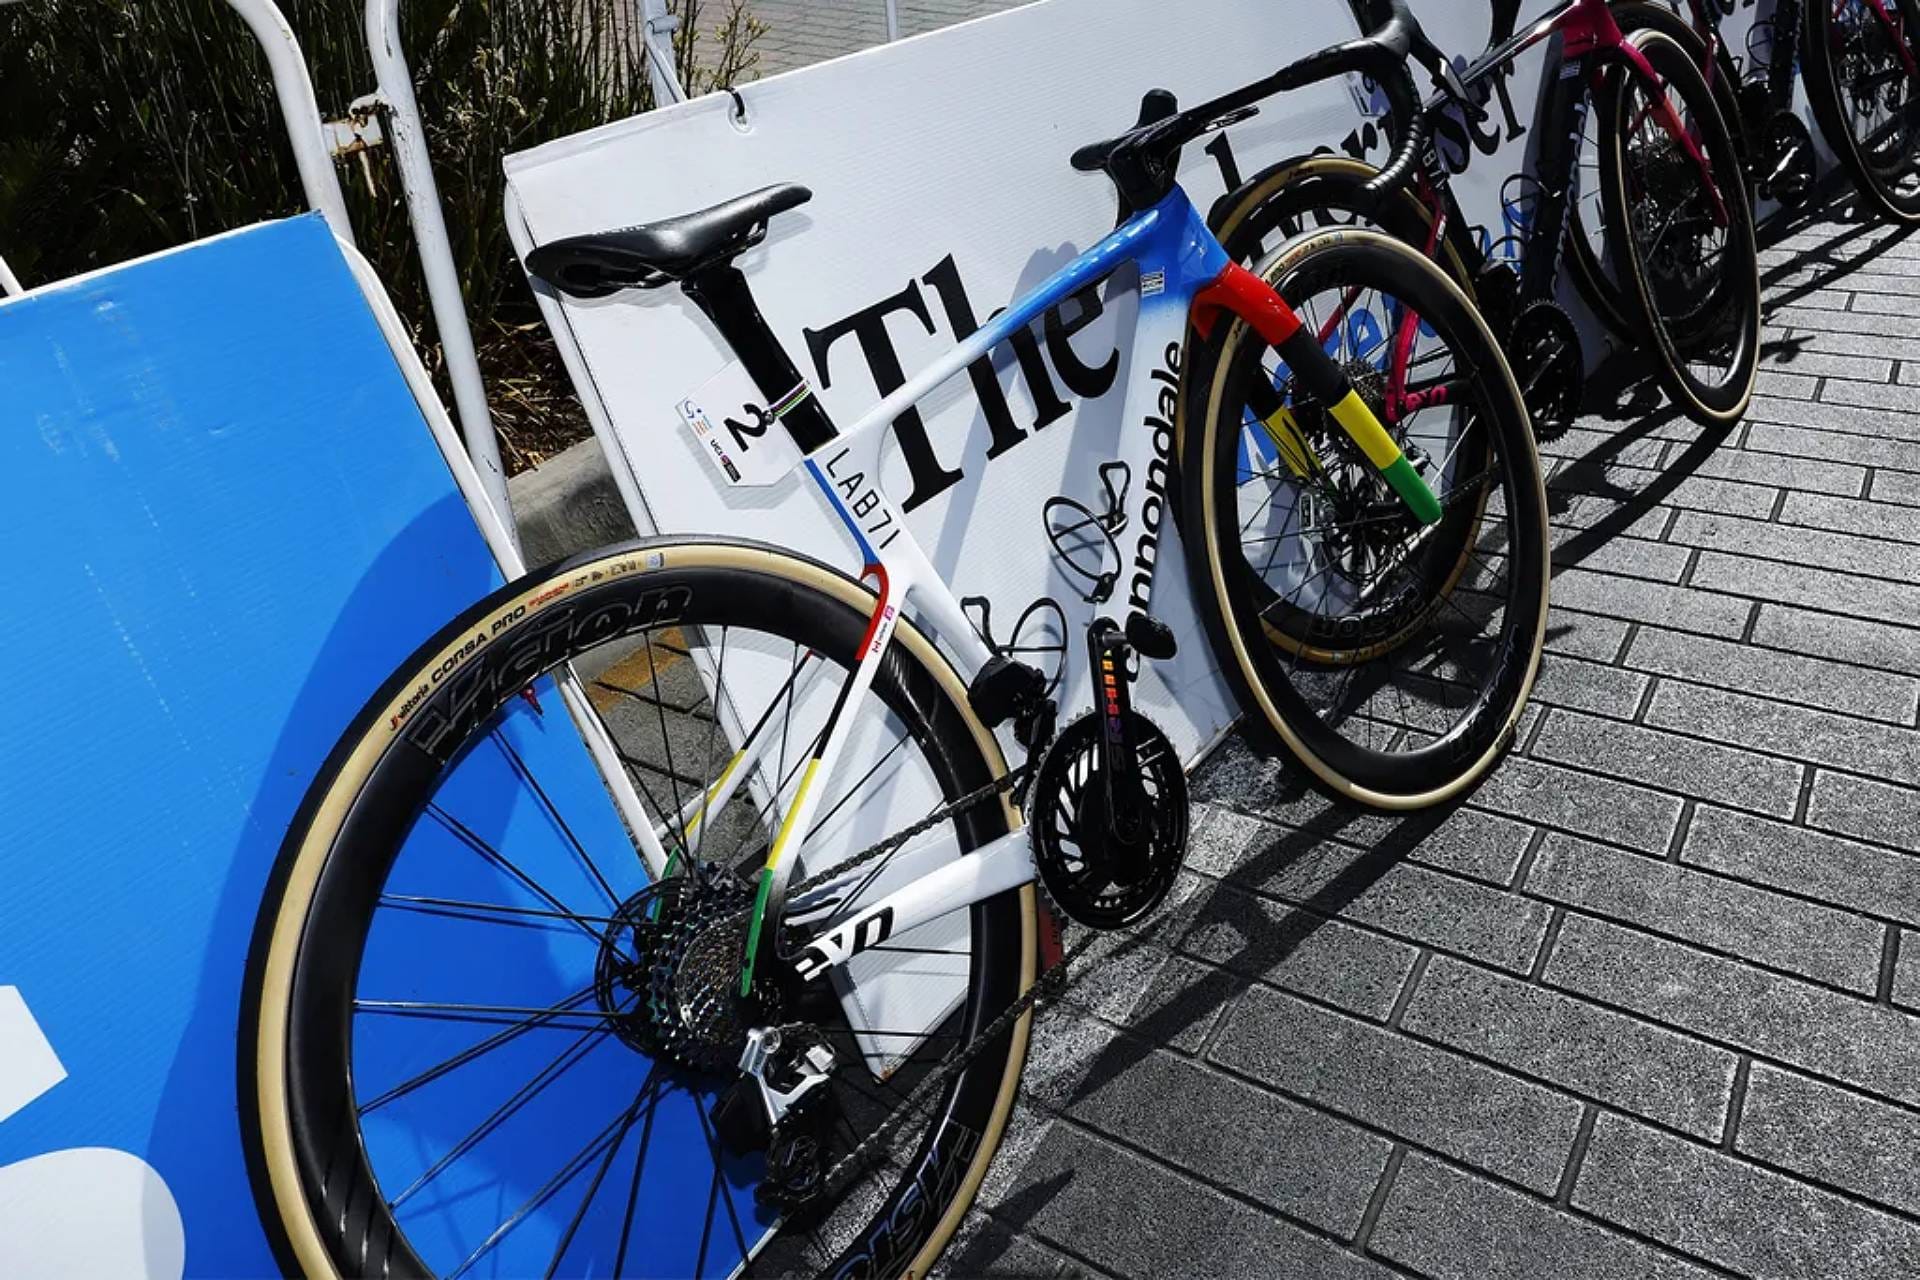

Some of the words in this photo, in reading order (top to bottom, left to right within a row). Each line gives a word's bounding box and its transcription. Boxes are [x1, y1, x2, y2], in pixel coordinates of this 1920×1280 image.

[724, 403, 768, 452] 2
[803, 253, 1121, 514] The
[825, 447, 901, 550] LAB71
[1125, 340, 1184, 683] cnnondale
[430, 632, 488, 684] CORSA
[490, 605, 527, 636] PRO
